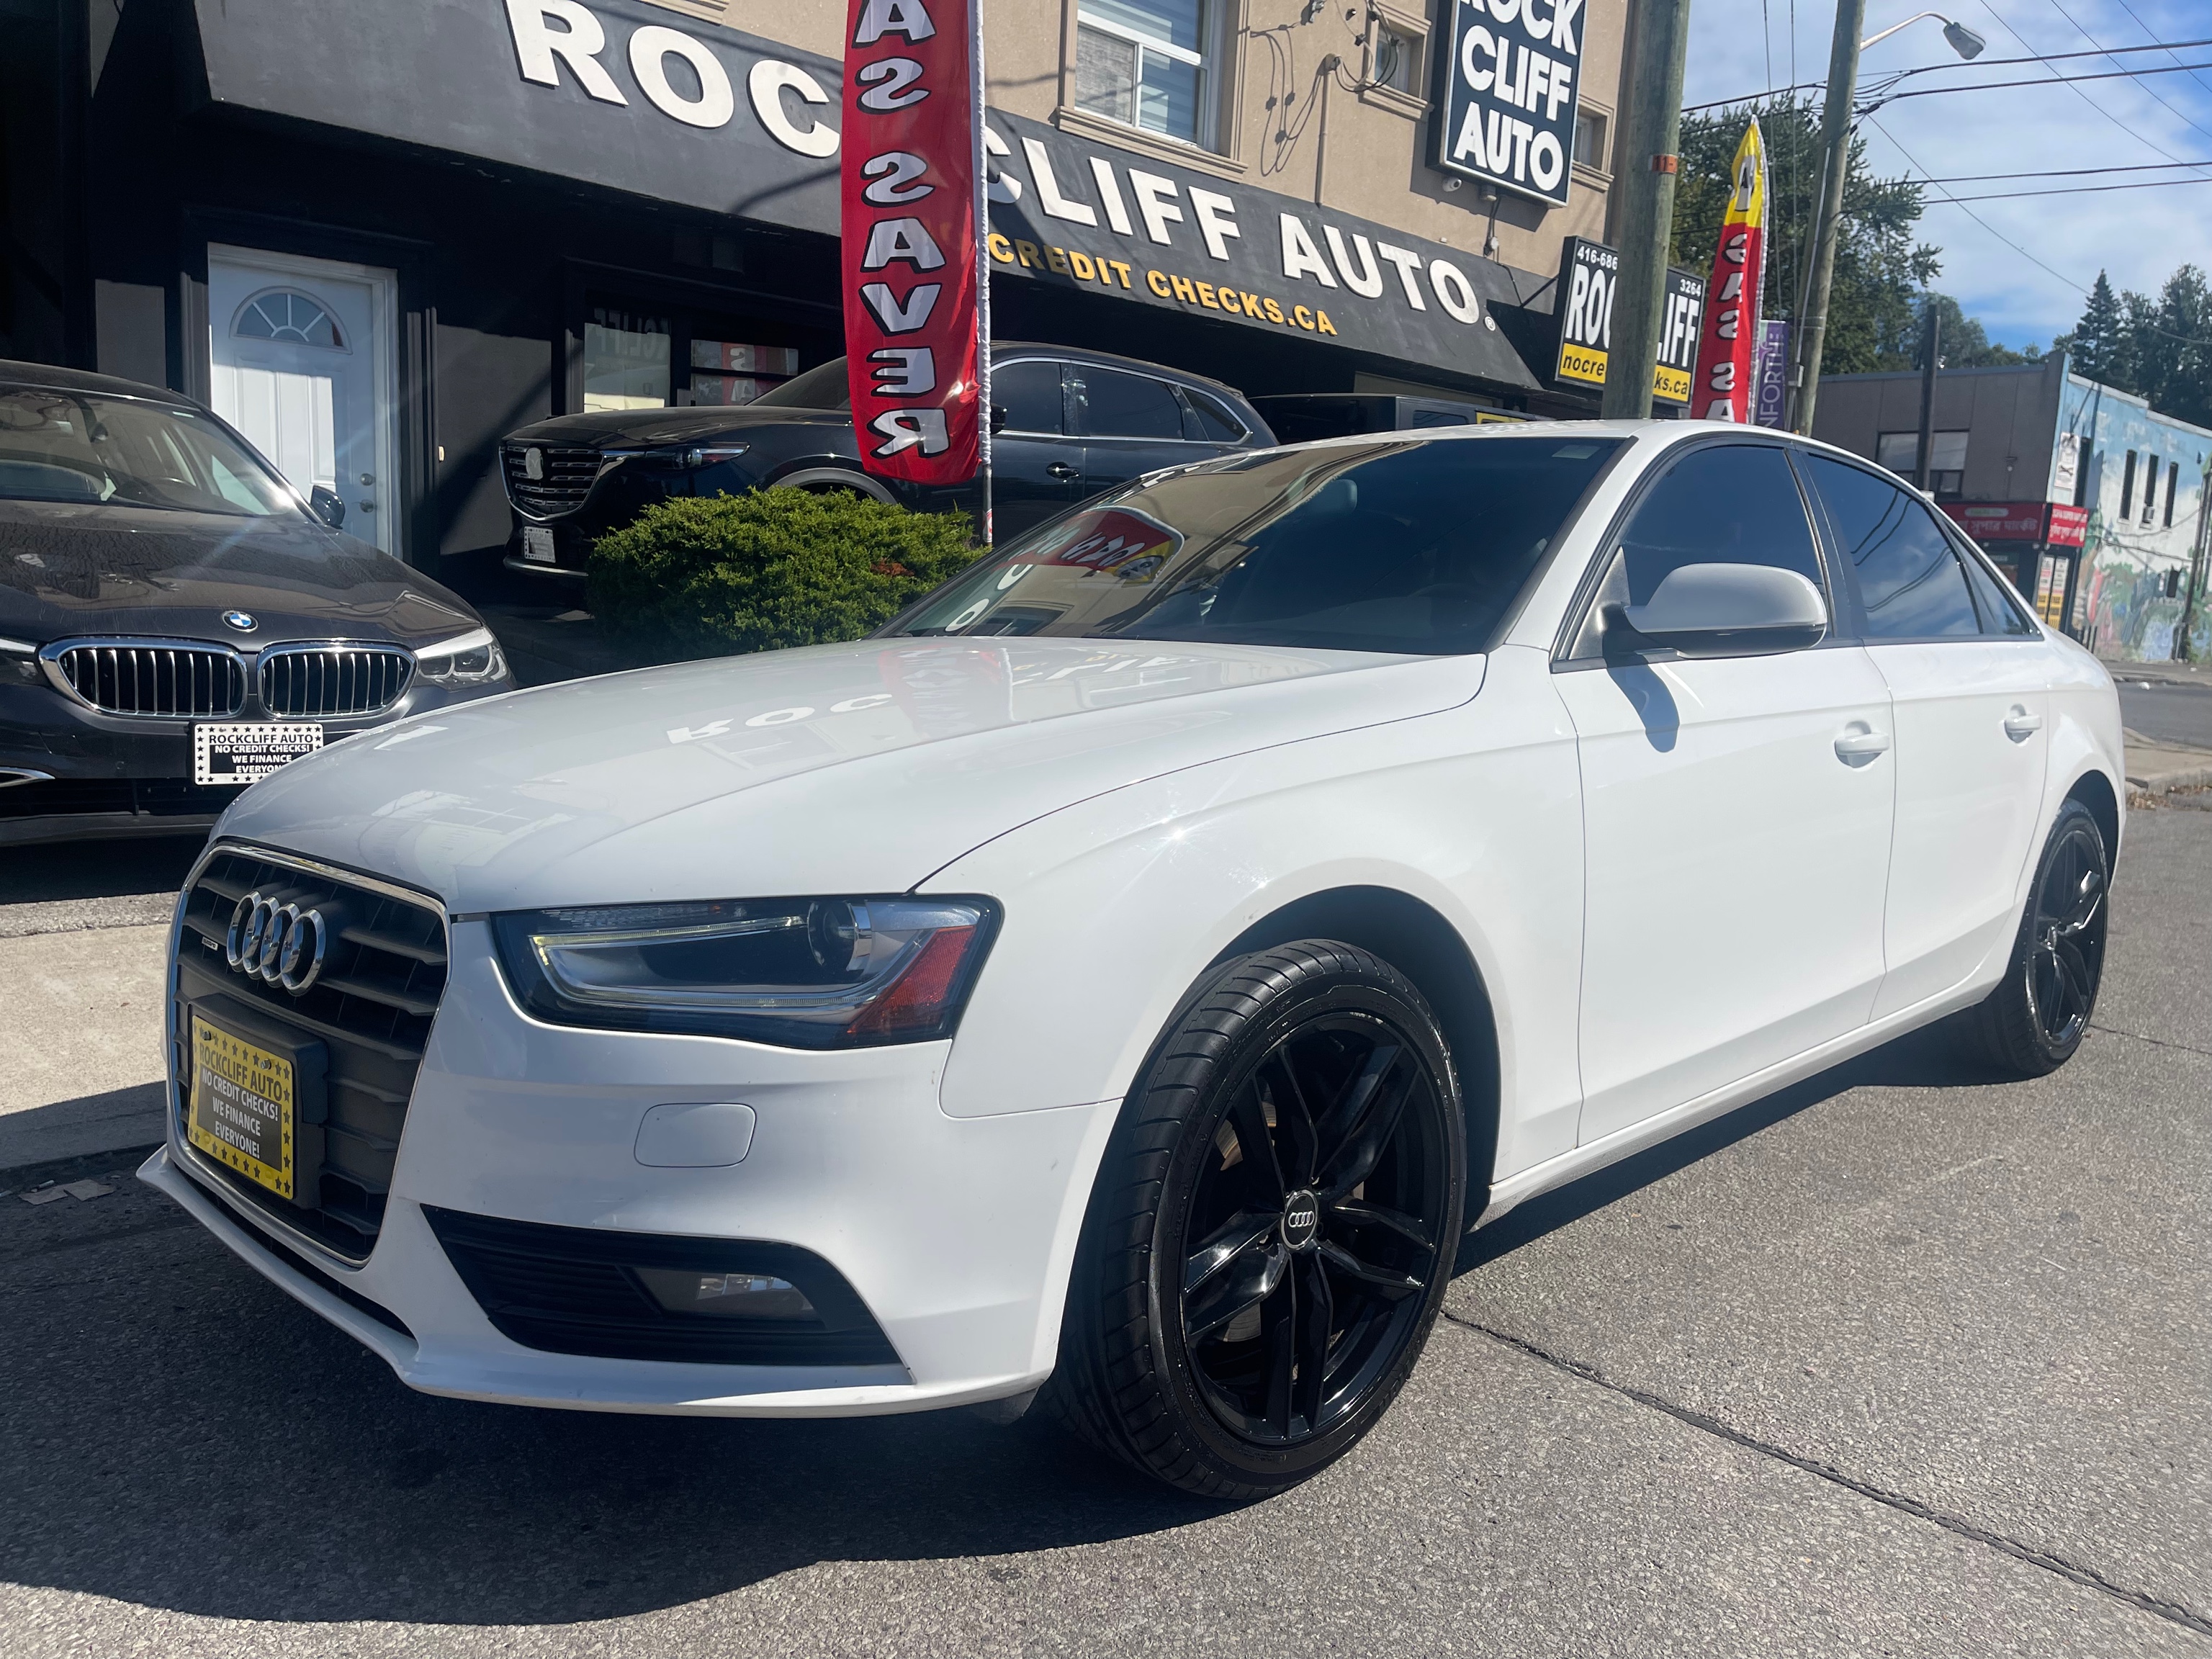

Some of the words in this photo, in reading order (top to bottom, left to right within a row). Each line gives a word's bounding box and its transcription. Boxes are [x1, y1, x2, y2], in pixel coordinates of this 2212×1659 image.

[1462, 25, 1573, 122] CLIFF
[1453, 102, 1564, 191] AUTO
[989, 233, 1133, 290] CREDIT
[1146, 269, 1338, 336] CHECKS.CA
[209, 734, 276, 744] ROCKCLIFF
[280, 734, 313, 743] AUTO
[232, 745, 269, 753] CREDIT
[269, 744, 310, 752] CHECKS!
[232, 755, 248, 763] WE
[249, 755, 292, 763] FINANCE
[235, 765, 284, 773] EVERYON
[199, 1042, 248, 1085] ROCKCLIFF
[250, 1070, 282, 1102] AUTO
[202, 1068, 212, 1087] NO
[213, 1075, 240, 1102] CREDIT
[241, 1090, 279, 1122] CHECKS!
[212, 1096, 224, 1117] WE
[225, 1107, 261, 1136] FINANCE
[215, 1120, 260, 1159] EVERYONE!
